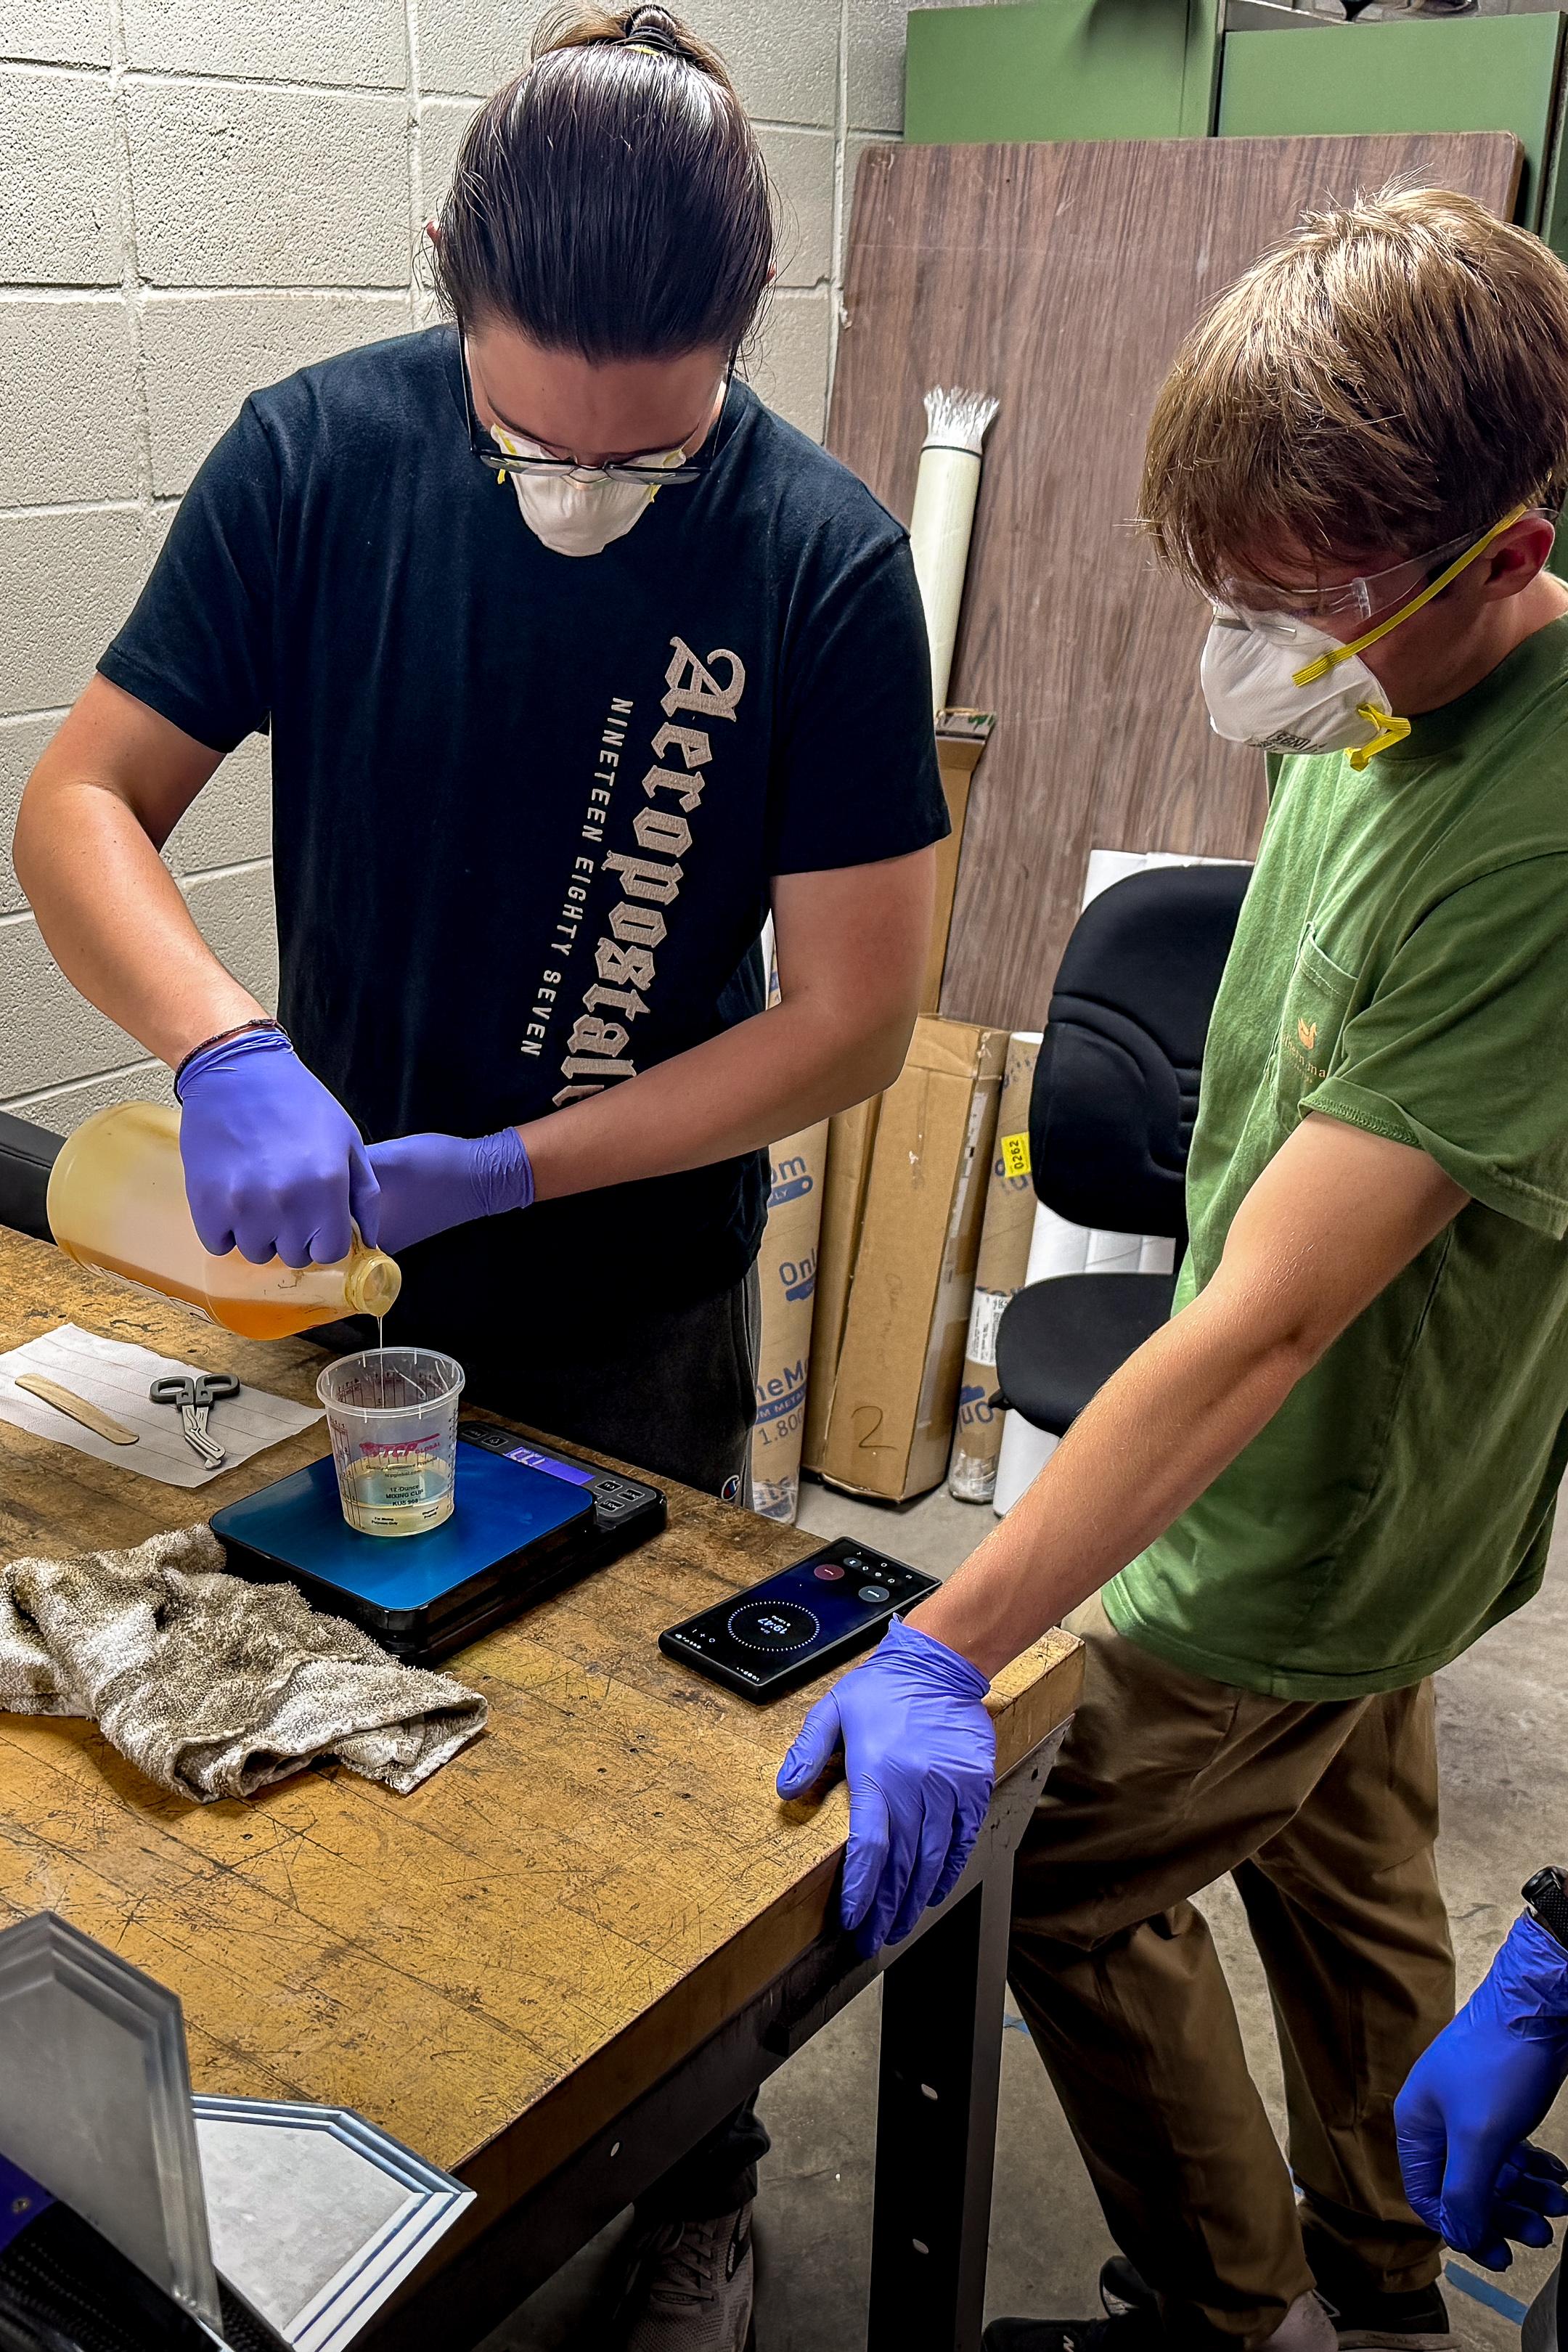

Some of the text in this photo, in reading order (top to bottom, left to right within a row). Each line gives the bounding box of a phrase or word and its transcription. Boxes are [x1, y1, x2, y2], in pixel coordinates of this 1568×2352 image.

[520, 697, 634, 1056] NINETEEN EIGHTY SEVEN
[1009, 1139, 1024, 1170] 0262
[756, 1360, 809, 1402] eM
[851, 1405, 899, 1451] 2
